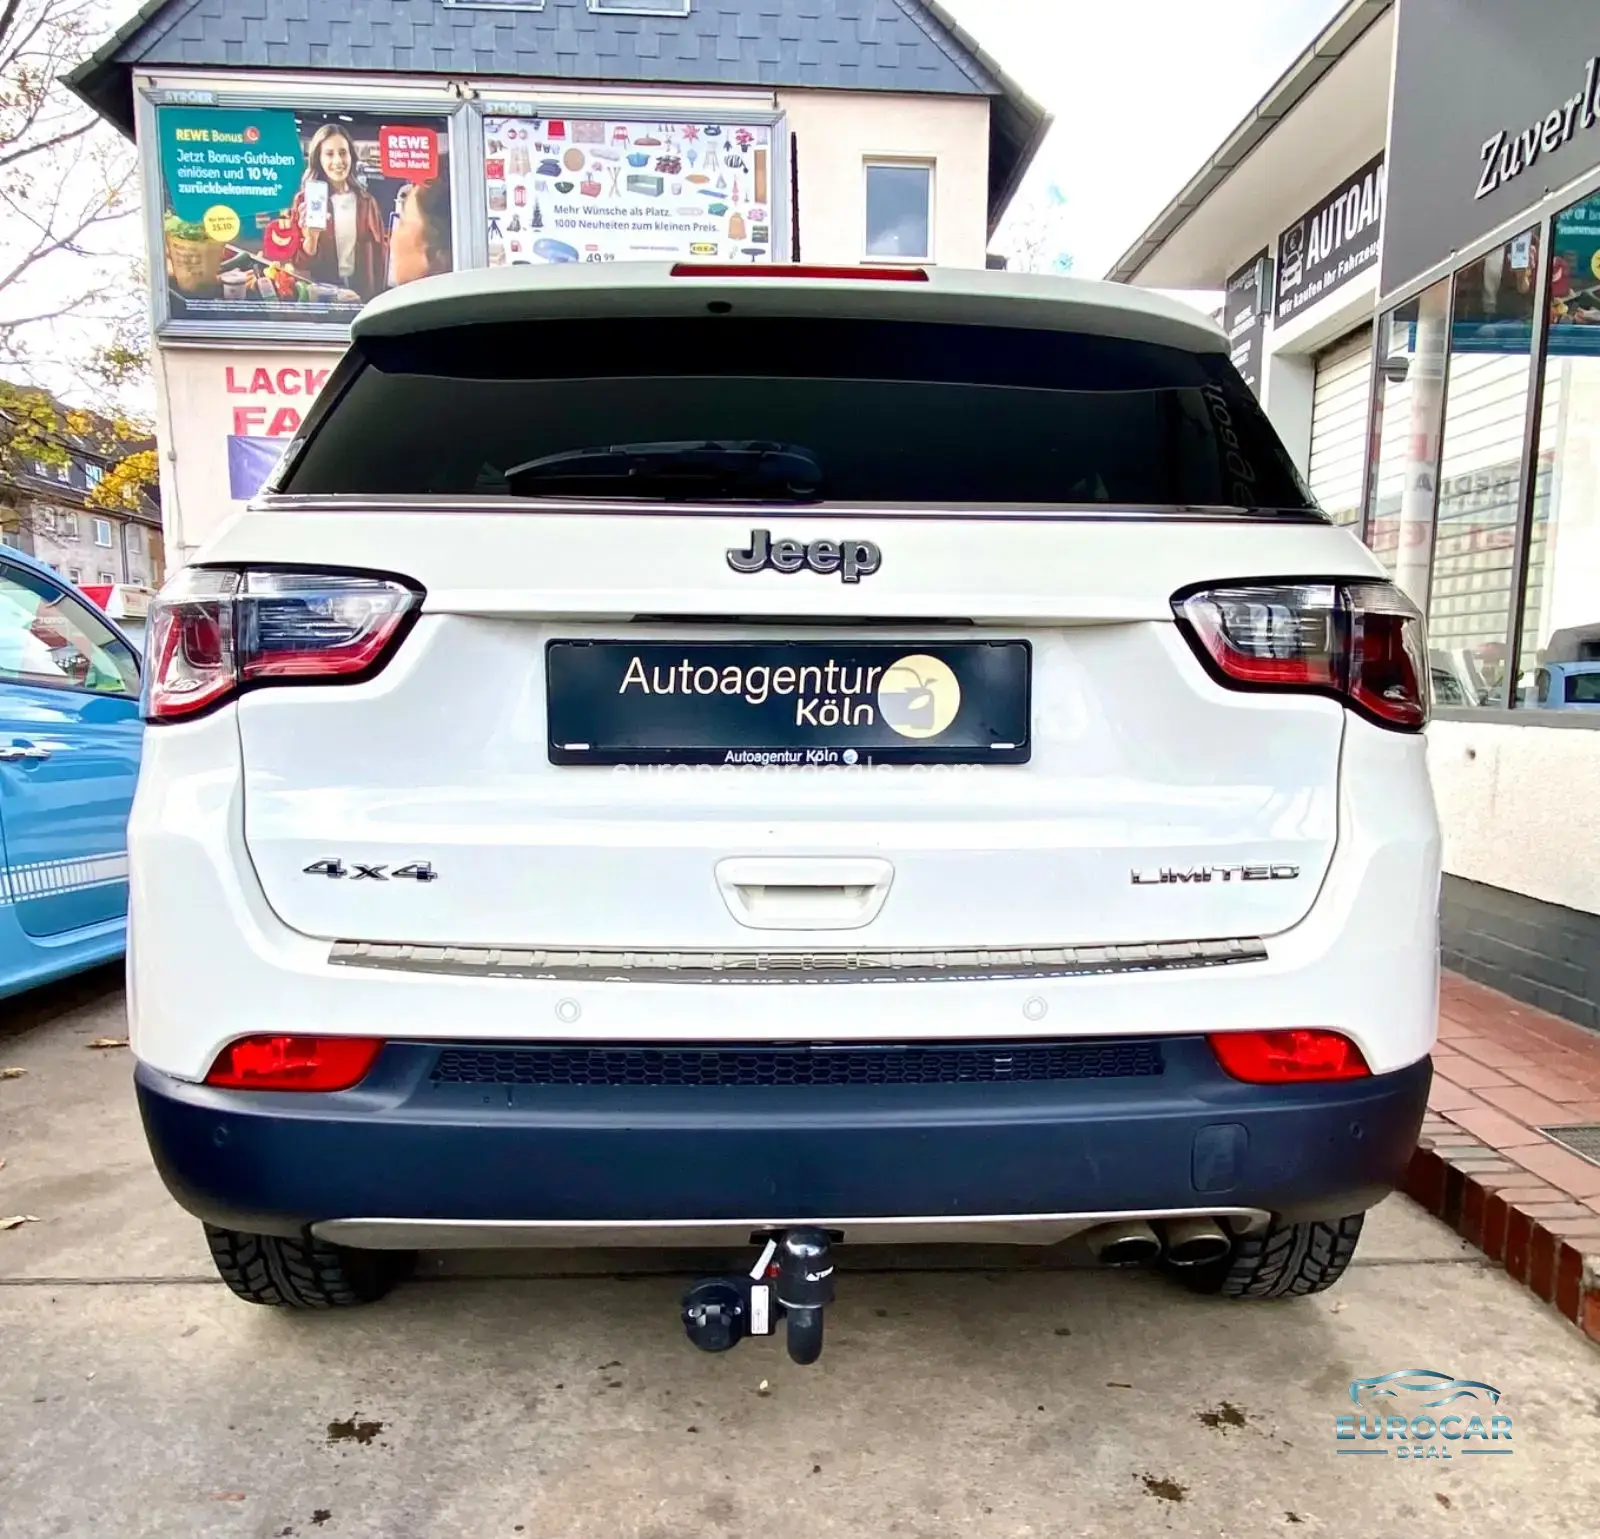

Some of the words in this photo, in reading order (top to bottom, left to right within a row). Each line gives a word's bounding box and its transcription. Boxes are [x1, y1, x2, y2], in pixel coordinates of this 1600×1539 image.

[175, 128, 210, 141] REWE
[211, 129, 244, 143] Bonus
[388, 135, 430, 149] REWE
[176, 148, 205, 163] Jetzt
[207, 150, 296, 166] Bonus-Guthaben
[177, 165, 221, 179] einlösen
[223, 167, 244, 180] und
[553, 205, 580, 215] Mehr
[582, 205, 627, 216] Wünsche
[629, 207, 643, 216] als
[645, 207, 673, 217] Platz.
[554, 219, 576, 229] 1000
[579, 220, 630, 230] Neuheiten
[631, 222, 653, 231] zum
[654, 221, 691, 231] kleinen
[693, 222, 720, 232] Preis.
[1279, 299, 1292, 317] Wir
[1294, 280, 1322, 308] kaufen
[225, 366, 332, 395] LACK
[233, 406, 302, 436] FA
[726, 529, 882, 583] Jeep
[619, 656, 882, 705] Autoagentur
[796, 698, 874, 727] Köln
[724, 750, 803, 765] Autoagentur
[806, 750, 838, 762] Köln
[302, 858, 438, 882] 4x4
[1130, 862, 1300, 885] LIMITED
